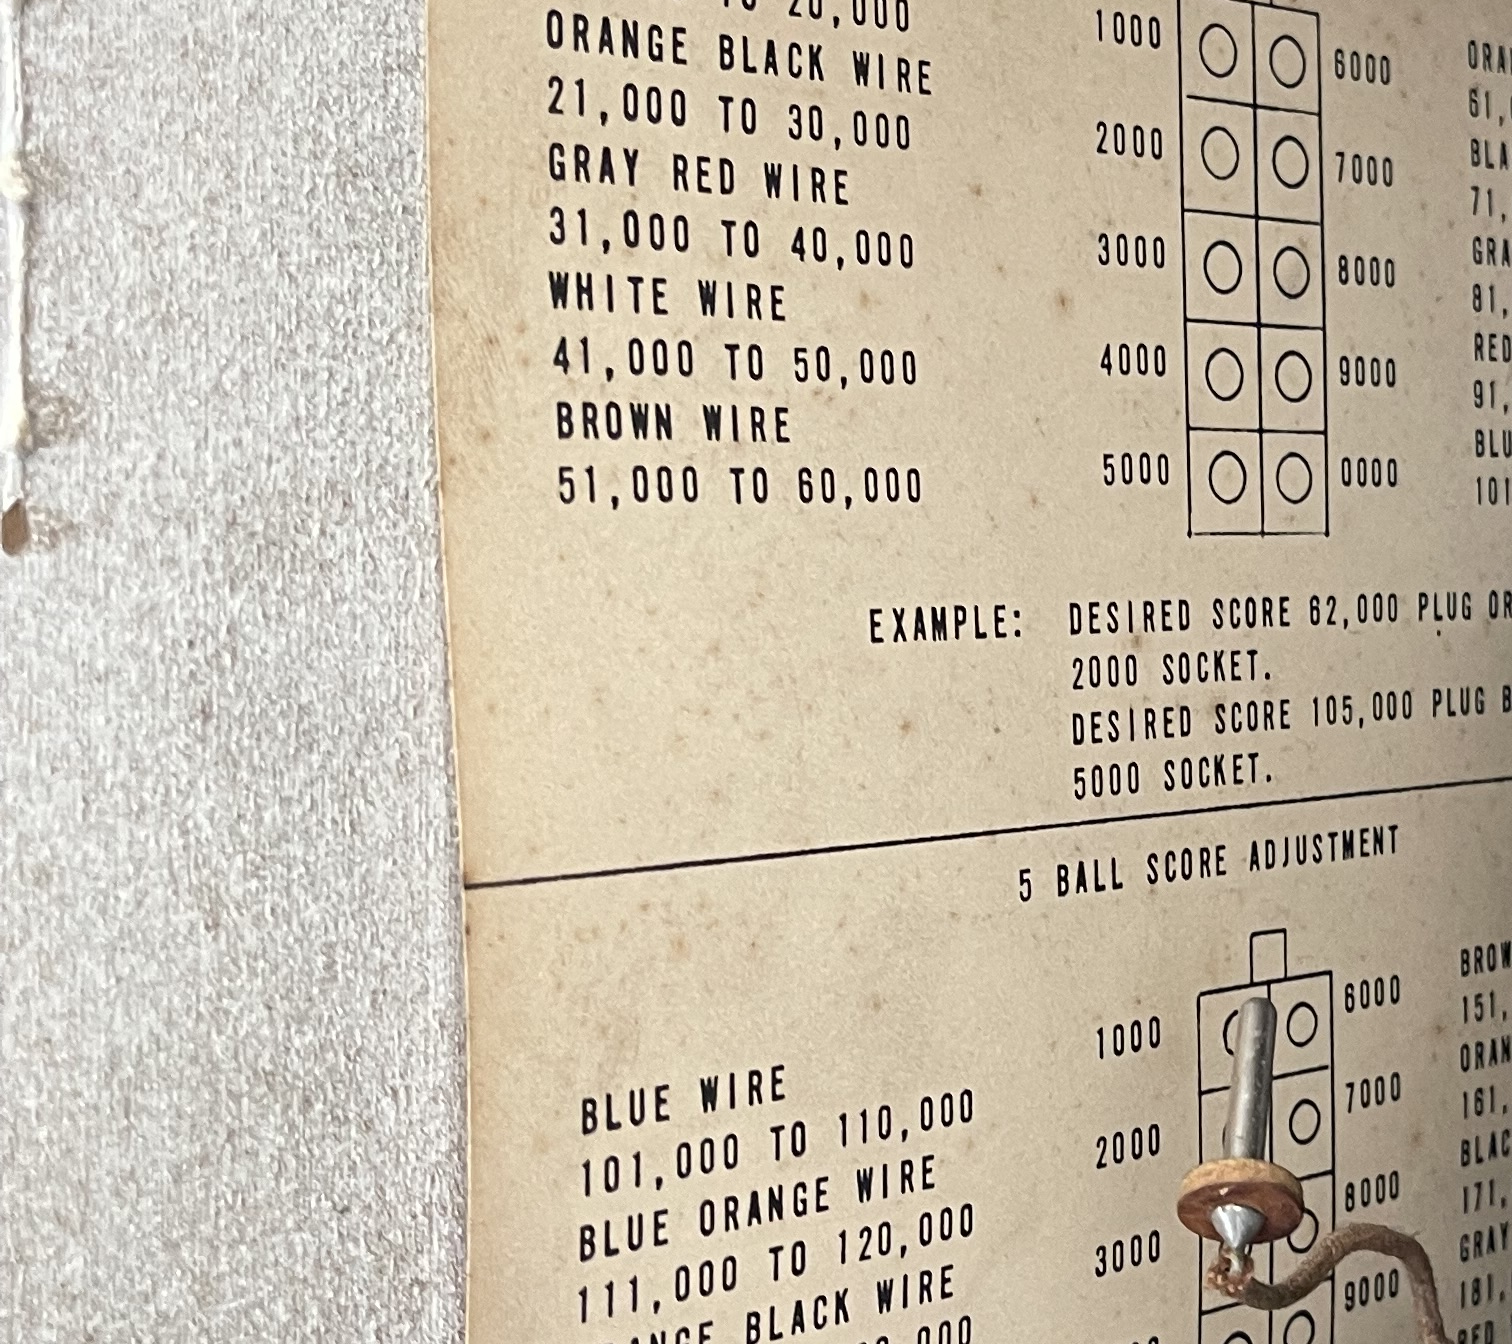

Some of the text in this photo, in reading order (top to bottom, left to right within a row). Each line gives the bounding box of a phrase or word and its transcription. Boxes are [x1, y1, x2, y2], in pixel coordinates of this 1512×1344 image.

[1095, 8, 1161, 50] 1000
[546, 8, 932, 96] ORANGE BLACK WIRE
[1334, 47, 1391, 86] 6000
[547, 75, 910, 152] 21,000 TO 30,000
[1096, 120, 1163, 161] 2000
[548, 142, 849, 206] GRAY RED WIRE
[1335, 151, 1394, 188] 7000
[1097, 232, 1165, 269] 3000
[1338, 254, 1396, 289] 8000
[548, 270, 786, 322] WHITE WIRE
[552, 335, 917, 391] 41,000 TO 50,000
[1100, 342, 1167, 378] 4000
[1339, 355, 1397, 388] 9000
[556, 400, 791, 444] BROWN WIRE
[558, 464, 921, 511] 51,000 TO 60,000
[1102, 451, 1169, 487] 5000
[1341, 456, 1398, 488] 0000
[869, 604, 1021, 644] EXAMPLE:
[1069, 598, 1191, 636] DESIRED
[1212, 595, 1291, 630] SCORE
[1309, 591, 1398, 630] 62,000
[1418, 591, 1472, 622] PLUG
[1072, 648, 1271, 691] 2000 SOCKET.
[1072, 705, 1192, 746] DESIRED
[1214, 698, 1291, 735] SCORE
[1312, 689, 1413, 730] 105,000
[1432, 685, 1485, 719] PLUG
[1073, 751, 1272, 801] 5000 SOCKET.
[1018, 823, 1399, 903] 5 BALL SCORE ADJUSTMENT
[1344, 974, 1401, 1014] 6000
[1096, 1015, 1161, 1060] 1000
[581, 1063, 786, 1137] BLUE WIRE
[1345, 1071, 1401, 1114] 7000
[581, 1088, 973, 1198] 101,000 TO 110,000
[1095, 1123, 1161, 1170] 2000
[1344, 1169, 1400, 1213] 8000
[1094, 1229, 1161, 1278] 3000
[876, 1263, 954, 1315] WIRE
[1344, 1268, 1400, 1313] 9000
